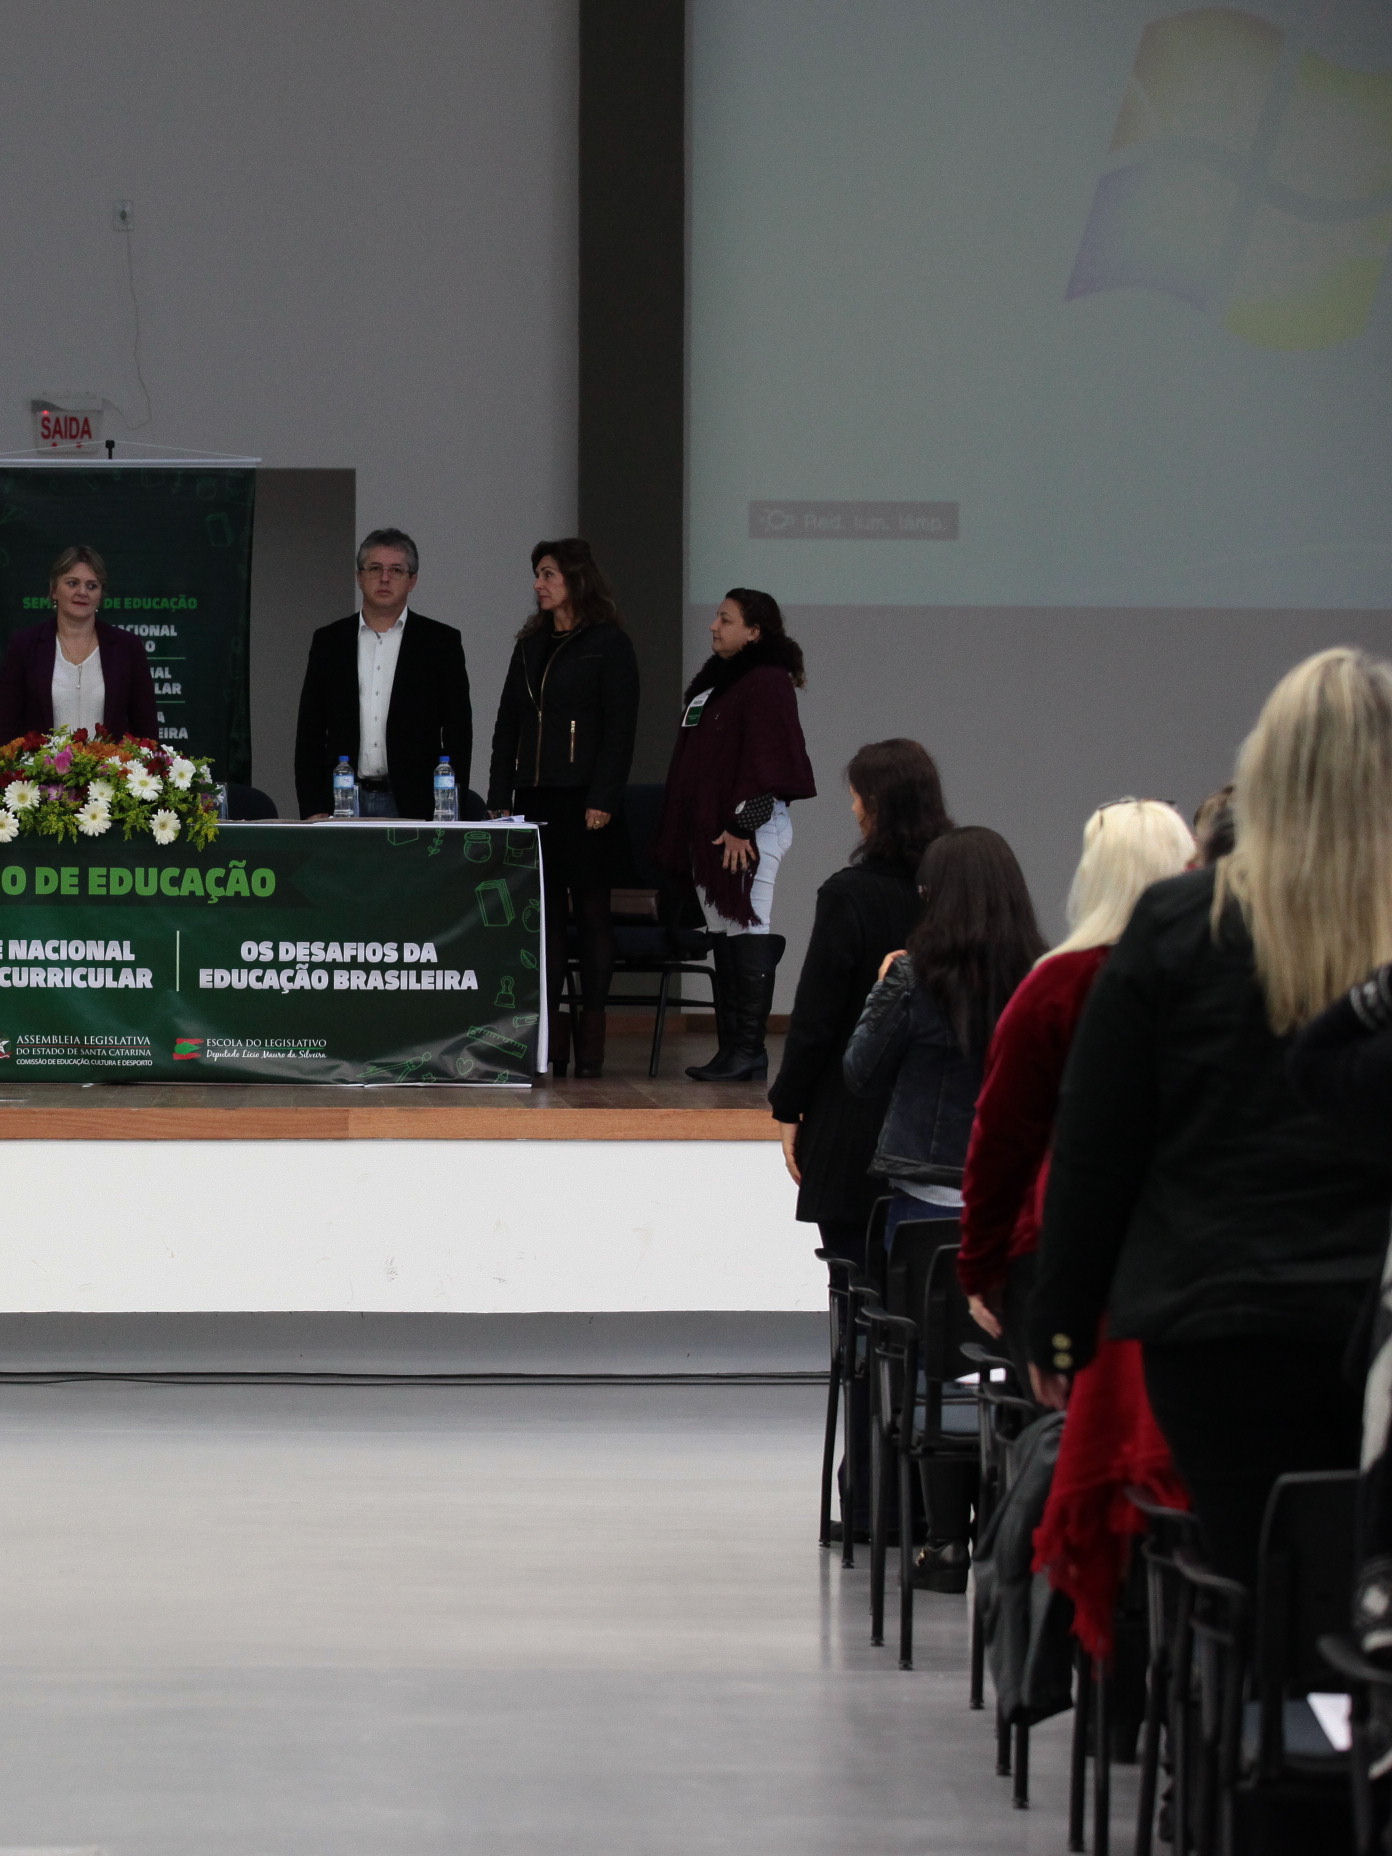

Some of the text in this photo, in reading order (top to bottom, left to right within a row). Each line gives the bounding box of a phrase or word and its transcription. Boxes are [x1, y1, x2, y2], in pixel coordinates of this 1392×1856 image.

[124, 595, 198, 612] EDUCAÇÃO
[35, 867, 79, 894] DE
[88, 860, 276, 904] EDUCAÇÃO
[8, 939, 135, 961] NACIONAL
[240, 941, 438, 963] OS DESAFIOS DA
[199, 963, 479, 994] EDUCAÇÃO BRASILEIRA
[16, 1035, 151, 1045] ASSEMBLEIA LEGISLATIVA
[206, 1038, 327, 1048] ESCOLA DO LEGISLATIVO
[16, 1047, 152, 1057] DO ESTADO DE SANTA CATARINA
[206, 1049, 240, 1062] Deputado
[16, 1057, 48, 1066] COMISSÃO
[122, 1059, 153, 1067] DESPORTO
